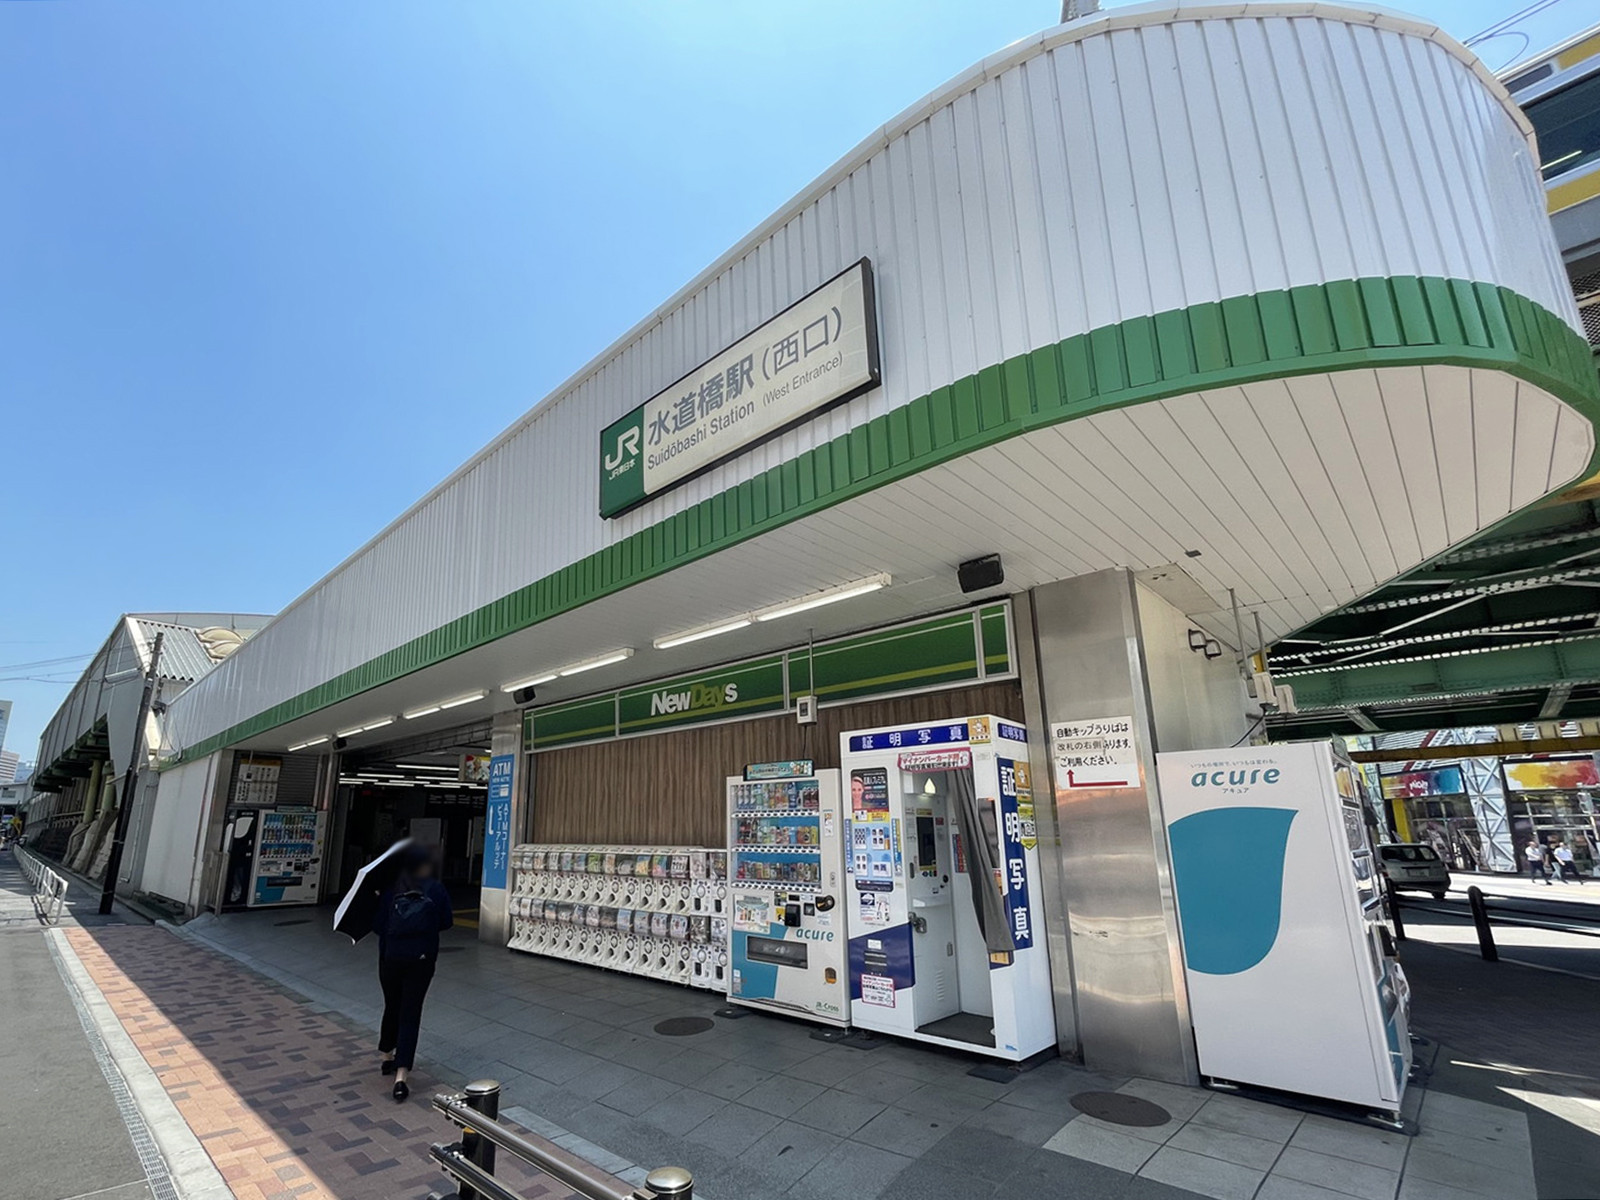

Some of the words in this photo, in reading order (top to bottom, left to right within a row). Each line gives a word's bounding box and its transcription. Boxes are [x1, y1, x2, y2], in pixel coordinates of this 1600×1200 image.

[647, 423, 708, 470] Suidōbashi
[710, 400, 755, 436] Station
[762, 381, 790, 408] (West
[792, 351, 843, 393] Entrance)
[604, 425, 640, 471] JR
[650, 681, 738, 717] NewDays
[862, 725, 964, 750] 証明写真
[1056, 722, 1129, 738] 自動キップうりばは
[492, 761, 511, 777] ATM
[1191, 768, 1280, 787] acure
[796, 928, 834, 942] acure
